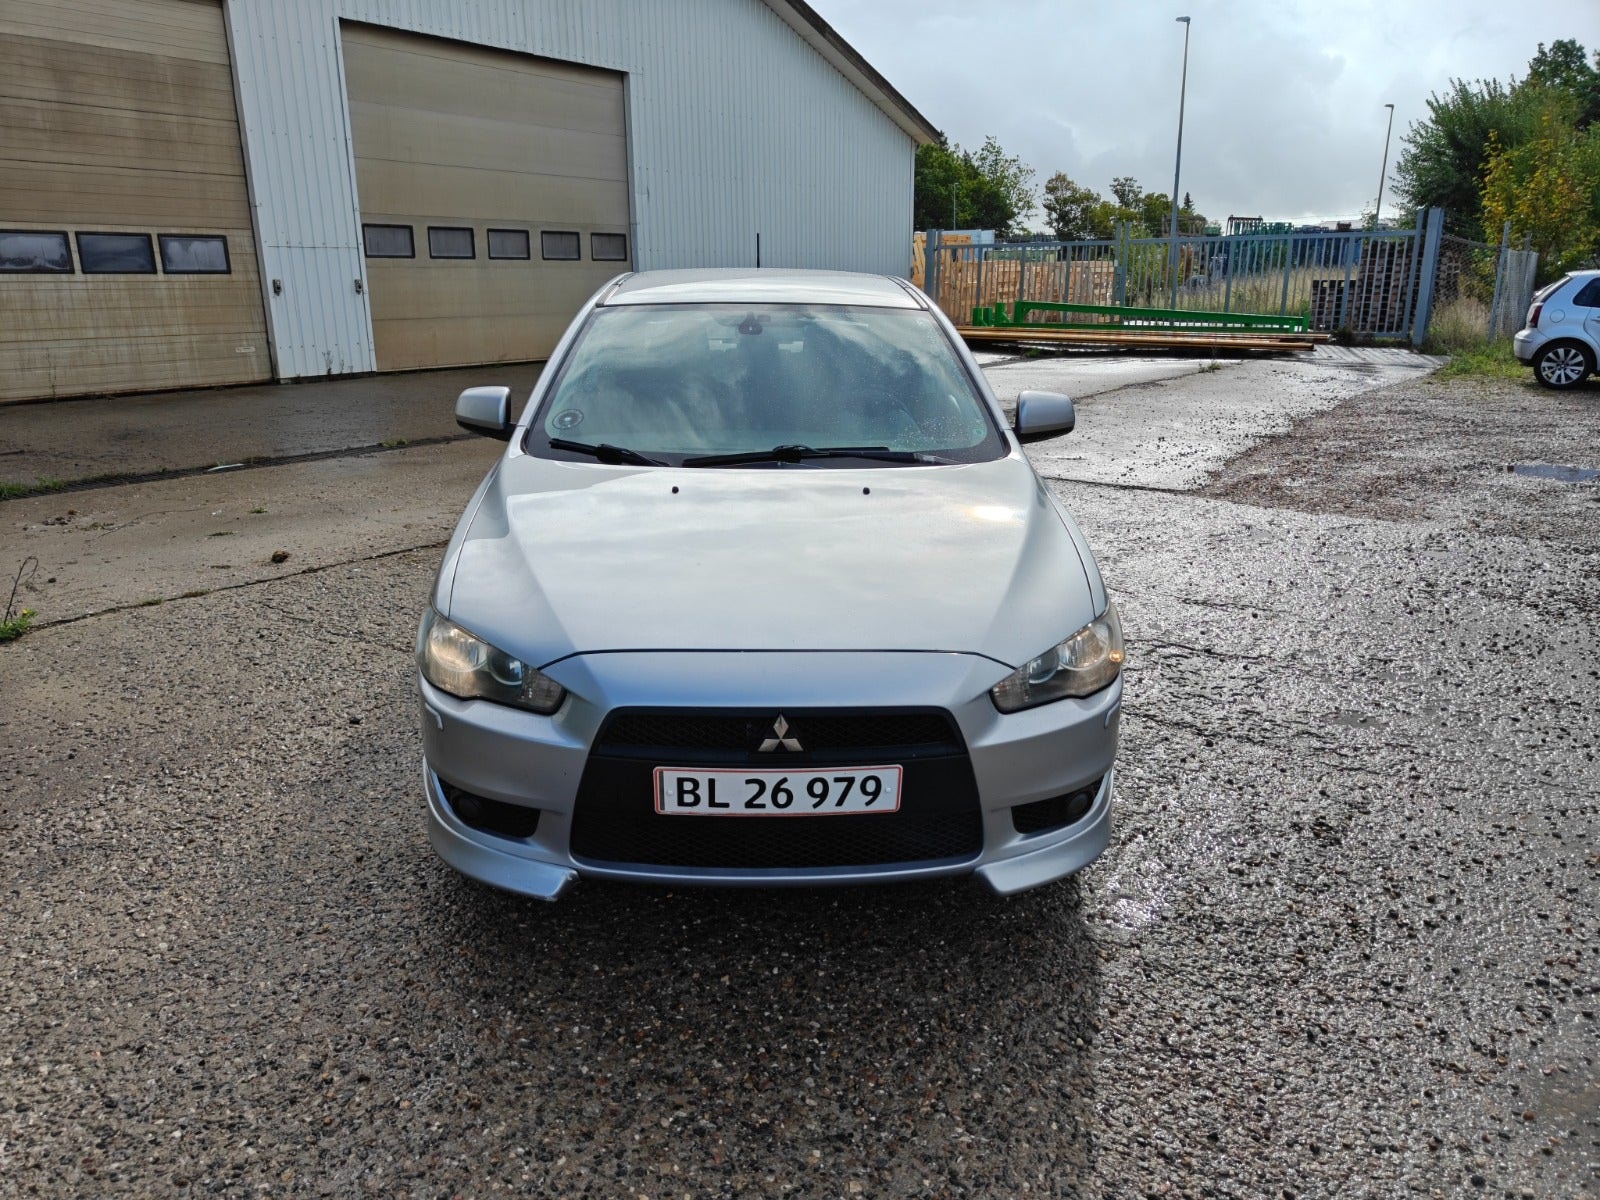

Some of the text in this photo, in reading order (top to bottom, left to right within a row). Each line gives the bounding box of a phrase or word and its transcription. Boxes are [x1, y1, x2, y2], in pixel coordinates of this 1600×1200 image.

[676, 775, 882, 809] BL 26 979
